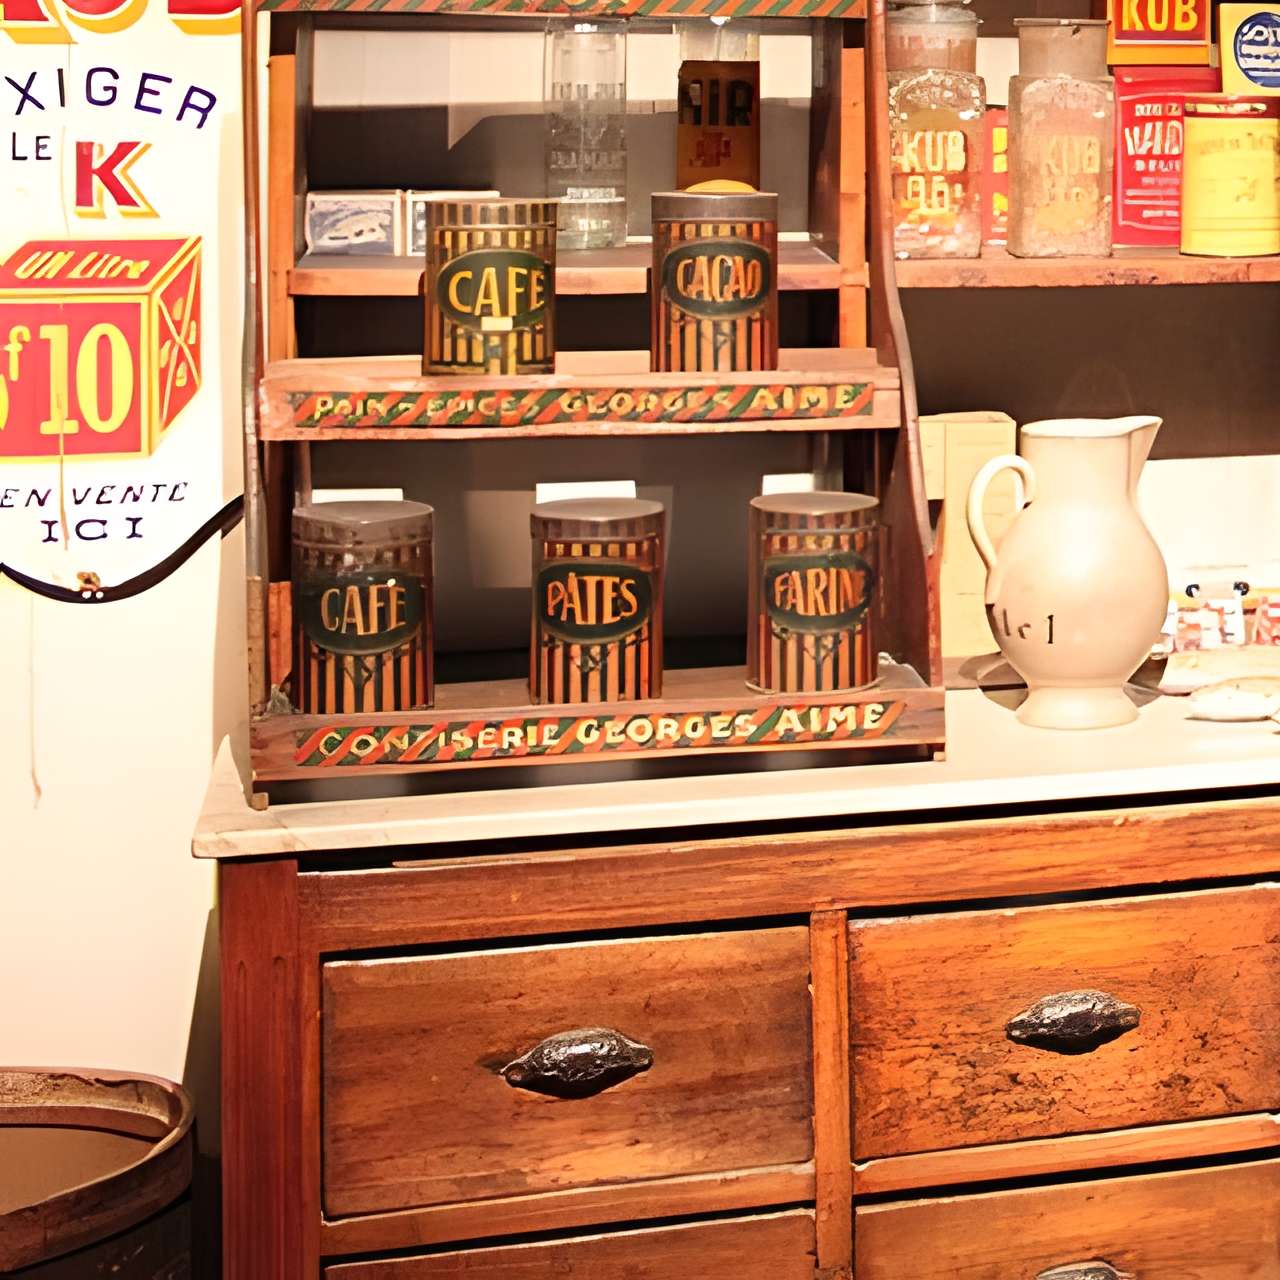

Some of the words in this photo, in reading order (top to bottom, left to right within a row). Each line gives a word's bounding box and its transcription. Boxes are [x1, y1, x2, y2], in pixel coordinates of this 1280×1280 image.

[898, 130, 966, 173] KUB
[11, 131, 52, 161] LE
[75, 140, 159, 219] K
[676, 255, 763, 304] CACAO
[0, 321, 135, 435] f10
[0, 486, 50, 508] EN
[72, 480, 189, 506] VENTE
[41, 515, 145, 544] ICI
[576, 712, 758, 744] GEORGES
